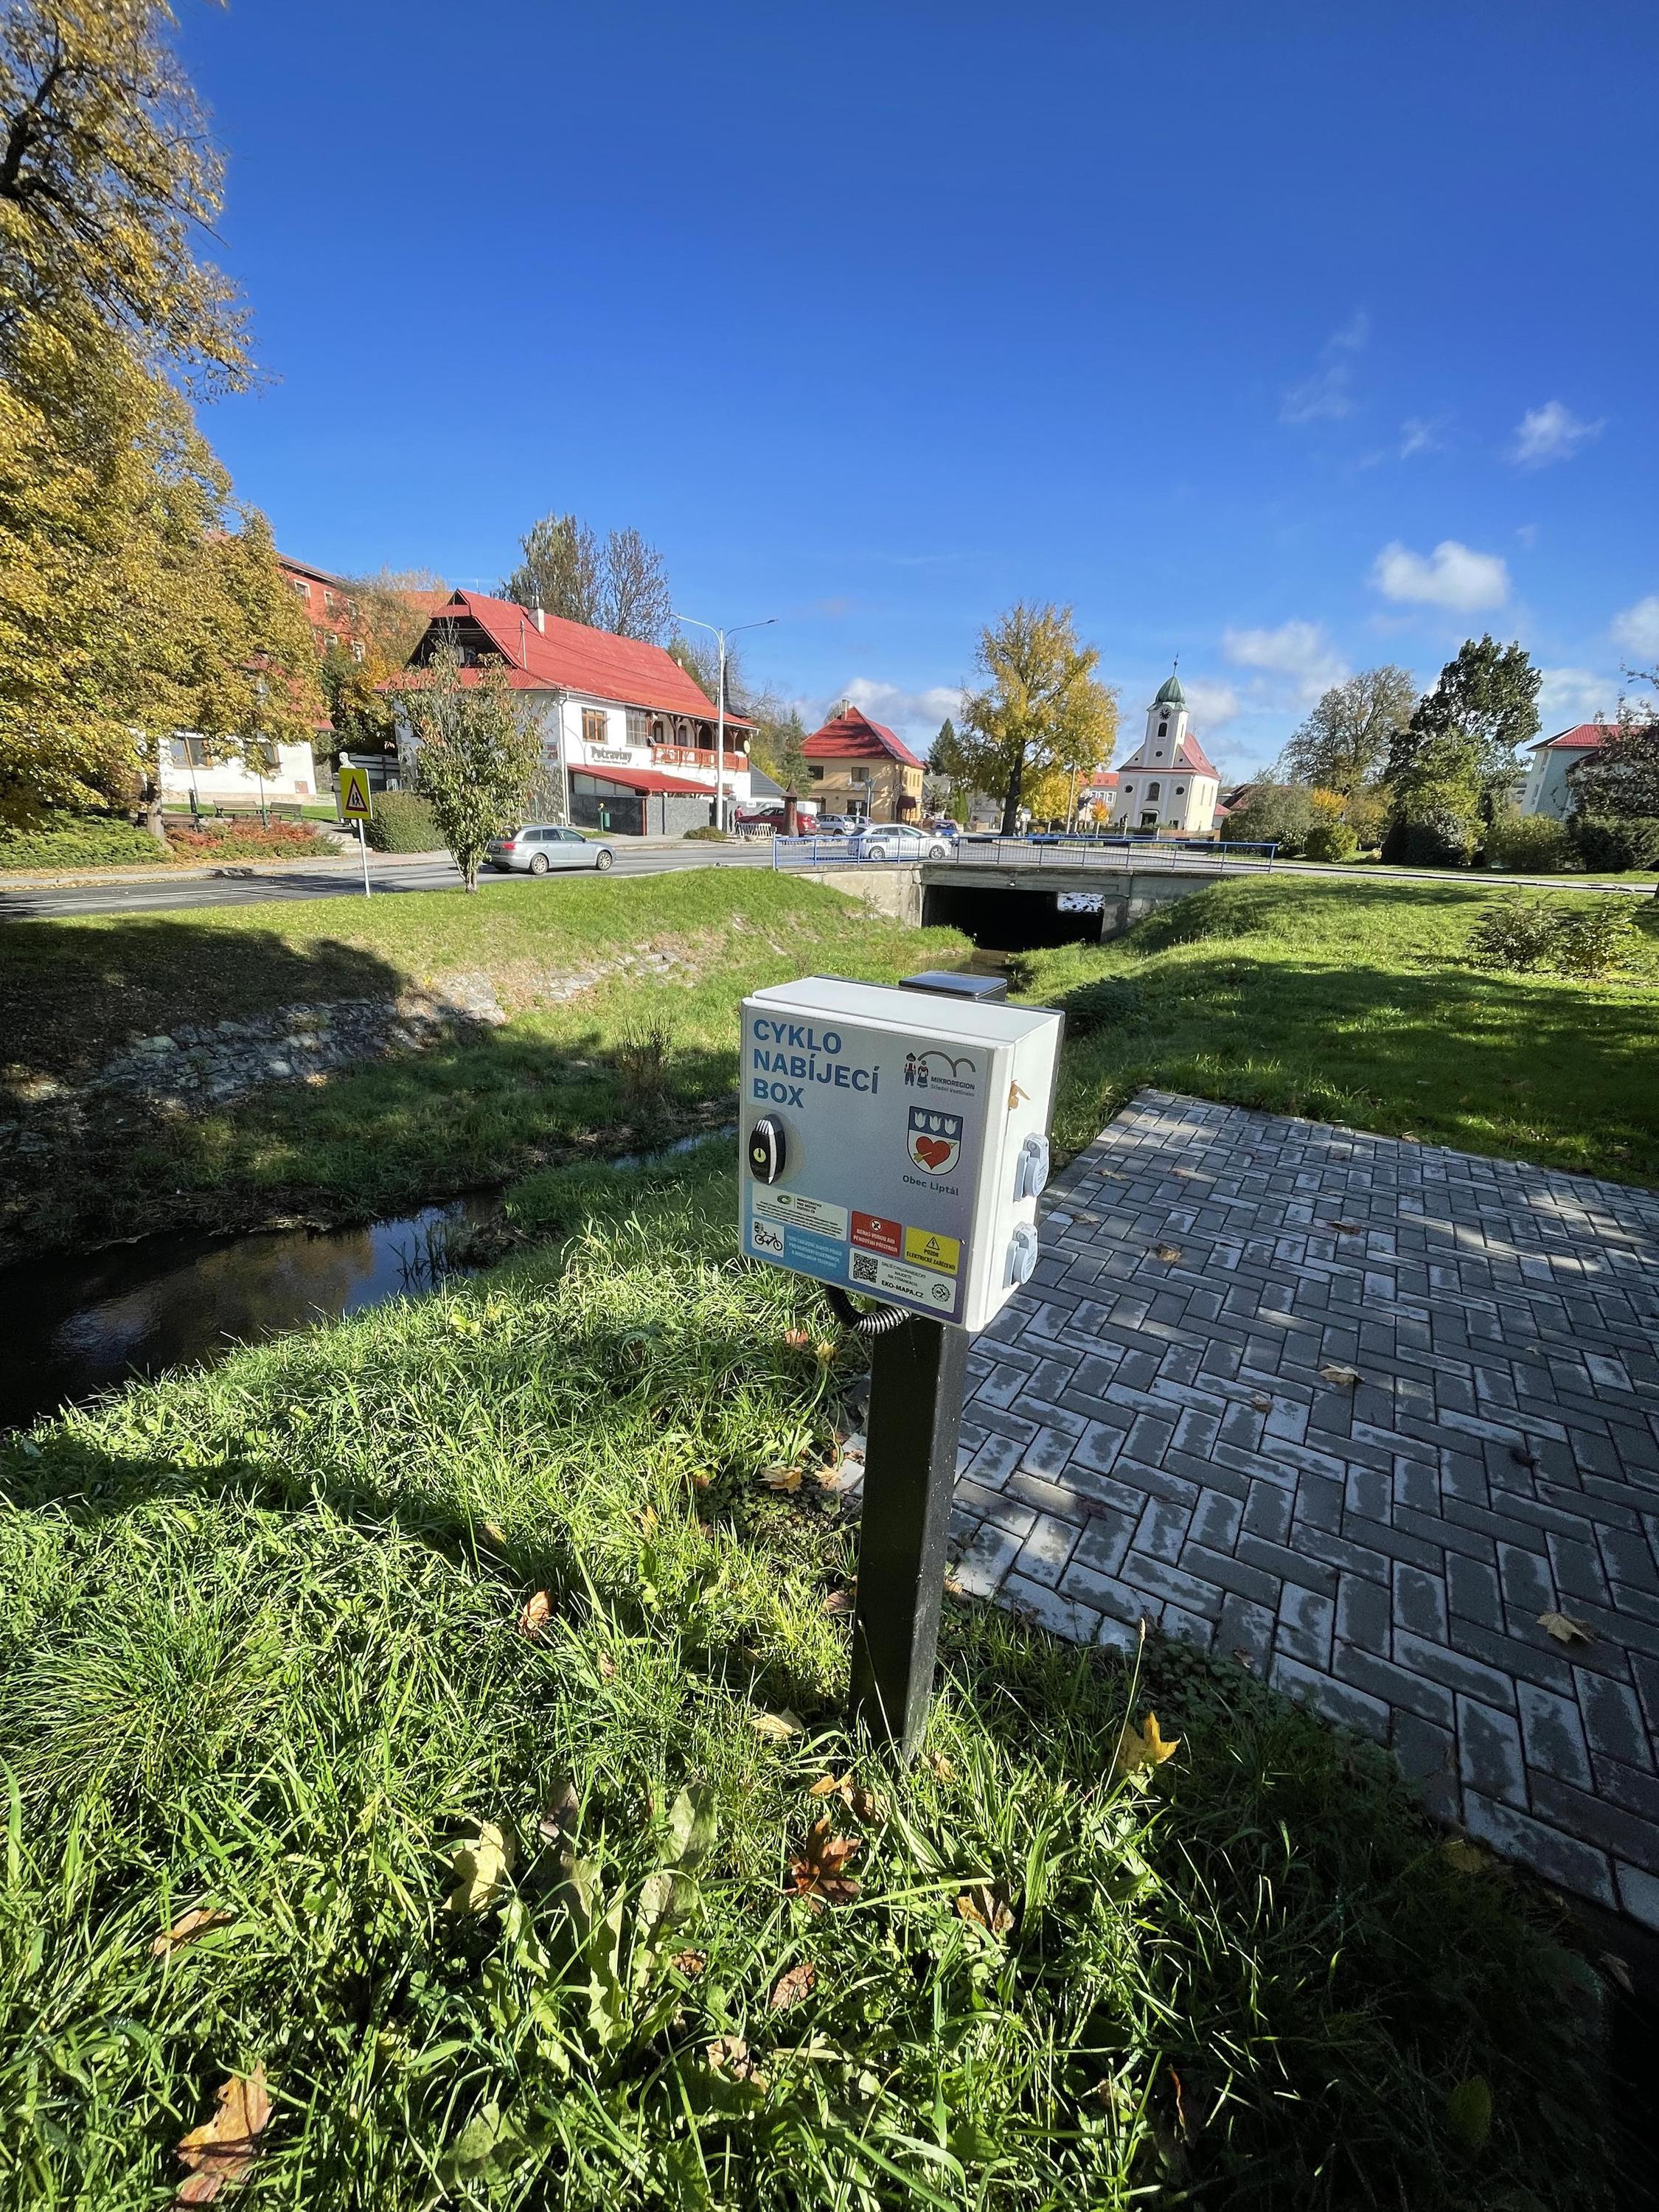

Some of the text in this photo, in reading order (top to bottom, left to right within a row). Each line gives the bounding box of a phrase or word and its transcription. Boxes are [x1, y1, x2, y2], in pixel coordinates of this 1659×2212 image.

[591, 745, 632, 763] Potraviny
[754, 1019, 841, 1054] CYKLO
[754, 1048, 880, 1094] NABÍJECÍ
[754, 1077, 804, 1108] BOX
[931, 1076, 975, 1090] MIKROREGION
[902, 1175, 959, 1196] Obec Liptál
[881, 1279, 925, 1298] EKO-MAPA.CZ
